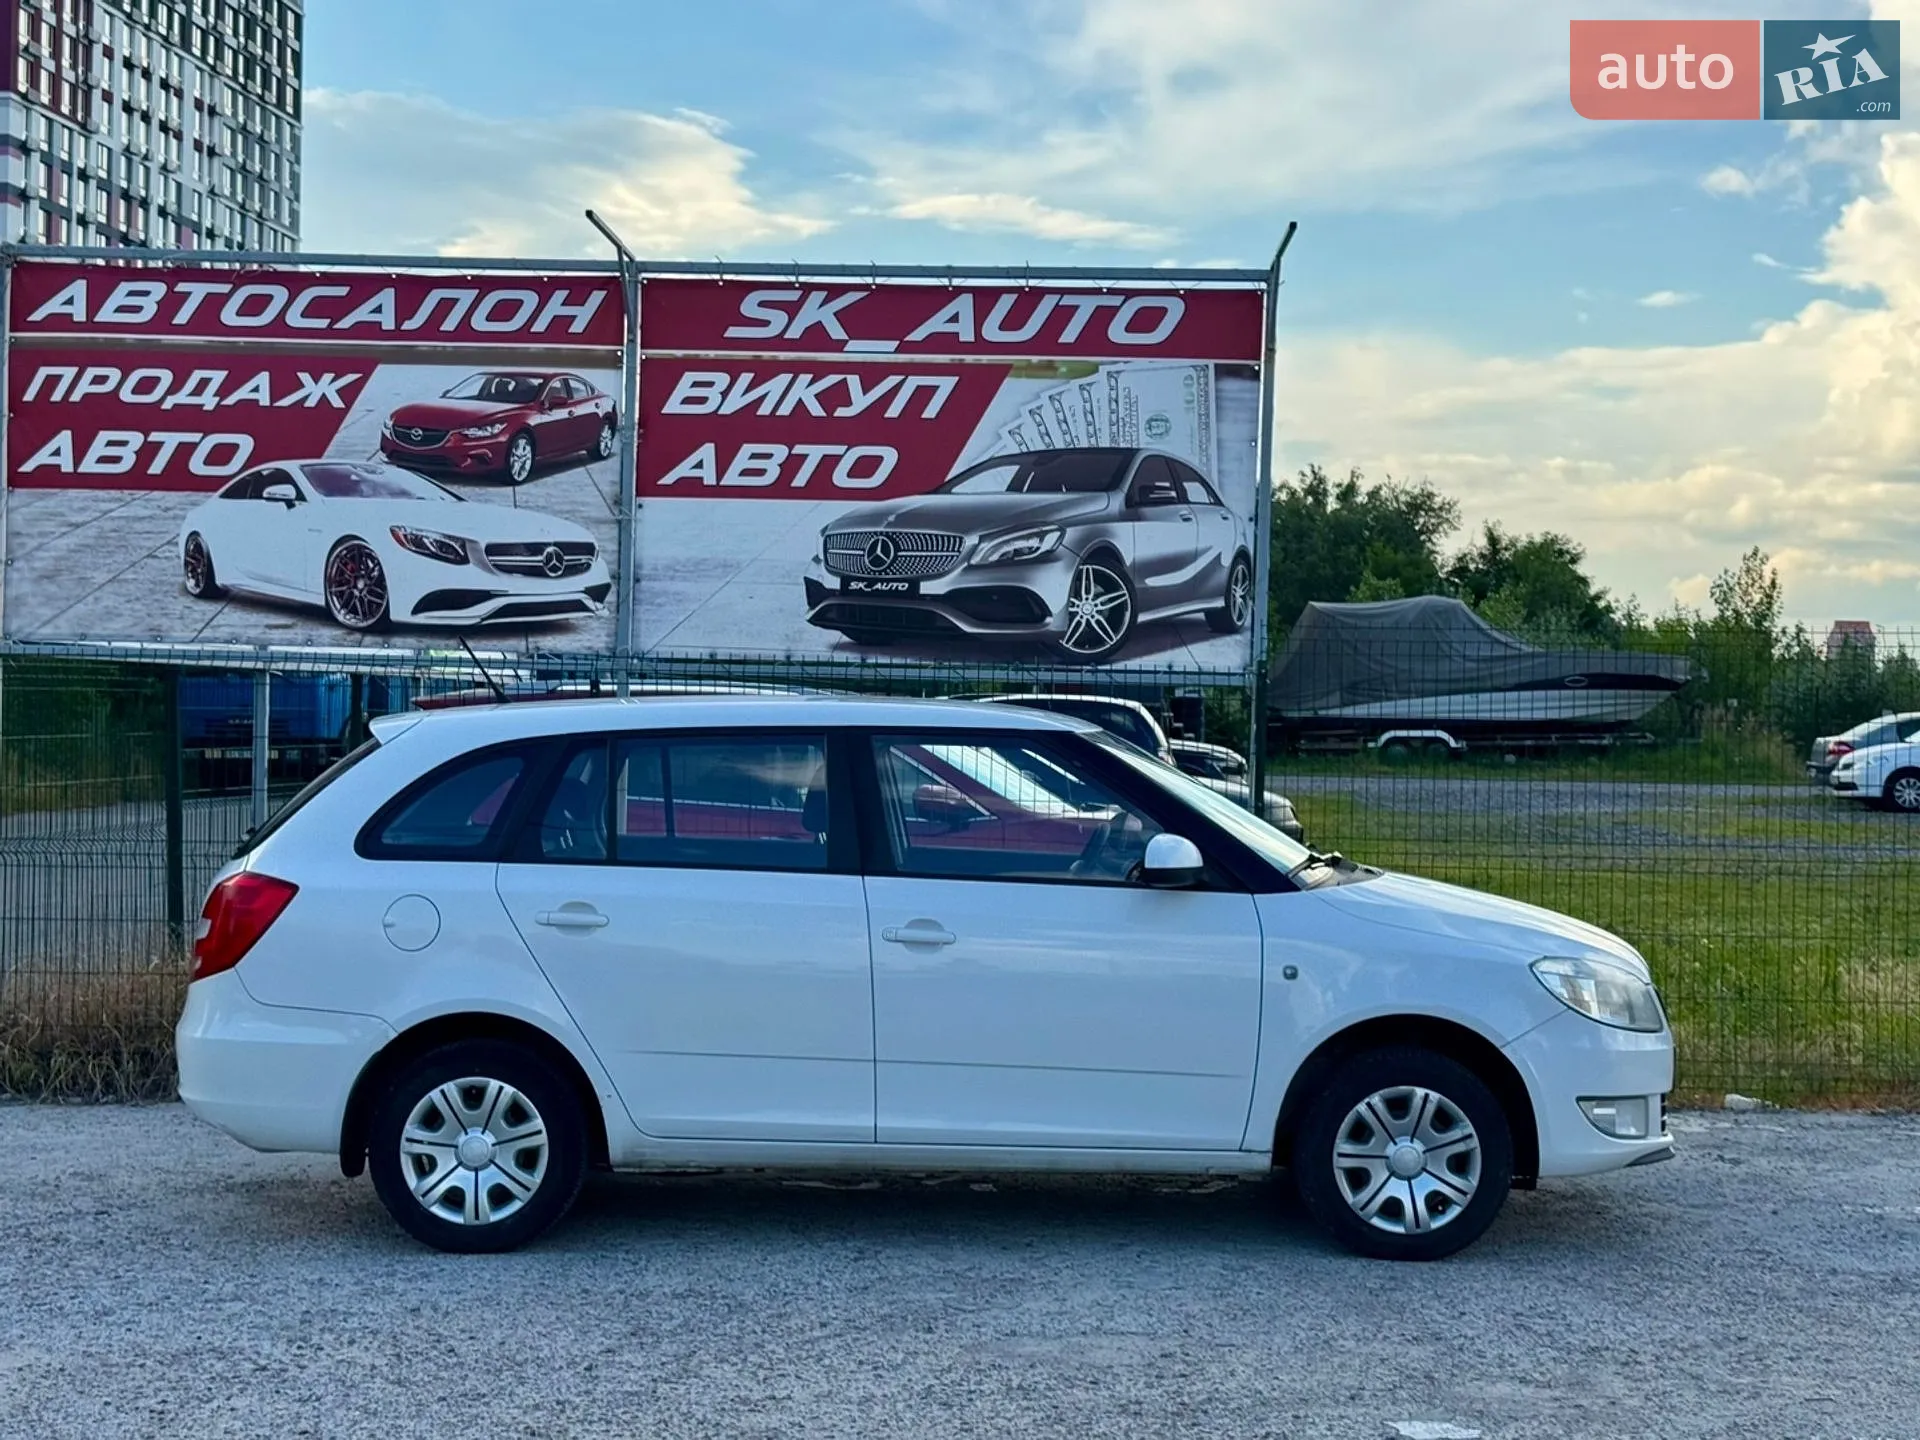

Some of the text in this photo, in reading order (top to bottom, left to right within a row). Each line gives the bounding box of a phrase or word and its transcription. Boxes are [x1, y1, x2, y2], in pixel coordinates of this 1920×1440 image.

[26, 278, 608, 335] АВТОСАЛОН
[723, 289, 1187, 352] SK_AUTO
[21, 365, 363, 411] ПРОДАЖ
[660, 371, 960, 420] ВИКУП
[18, 429, 256, 477] АВТО
[656, 442, 900, 489] АВТО
[847, 580, 909, 592] SK_AUTO
